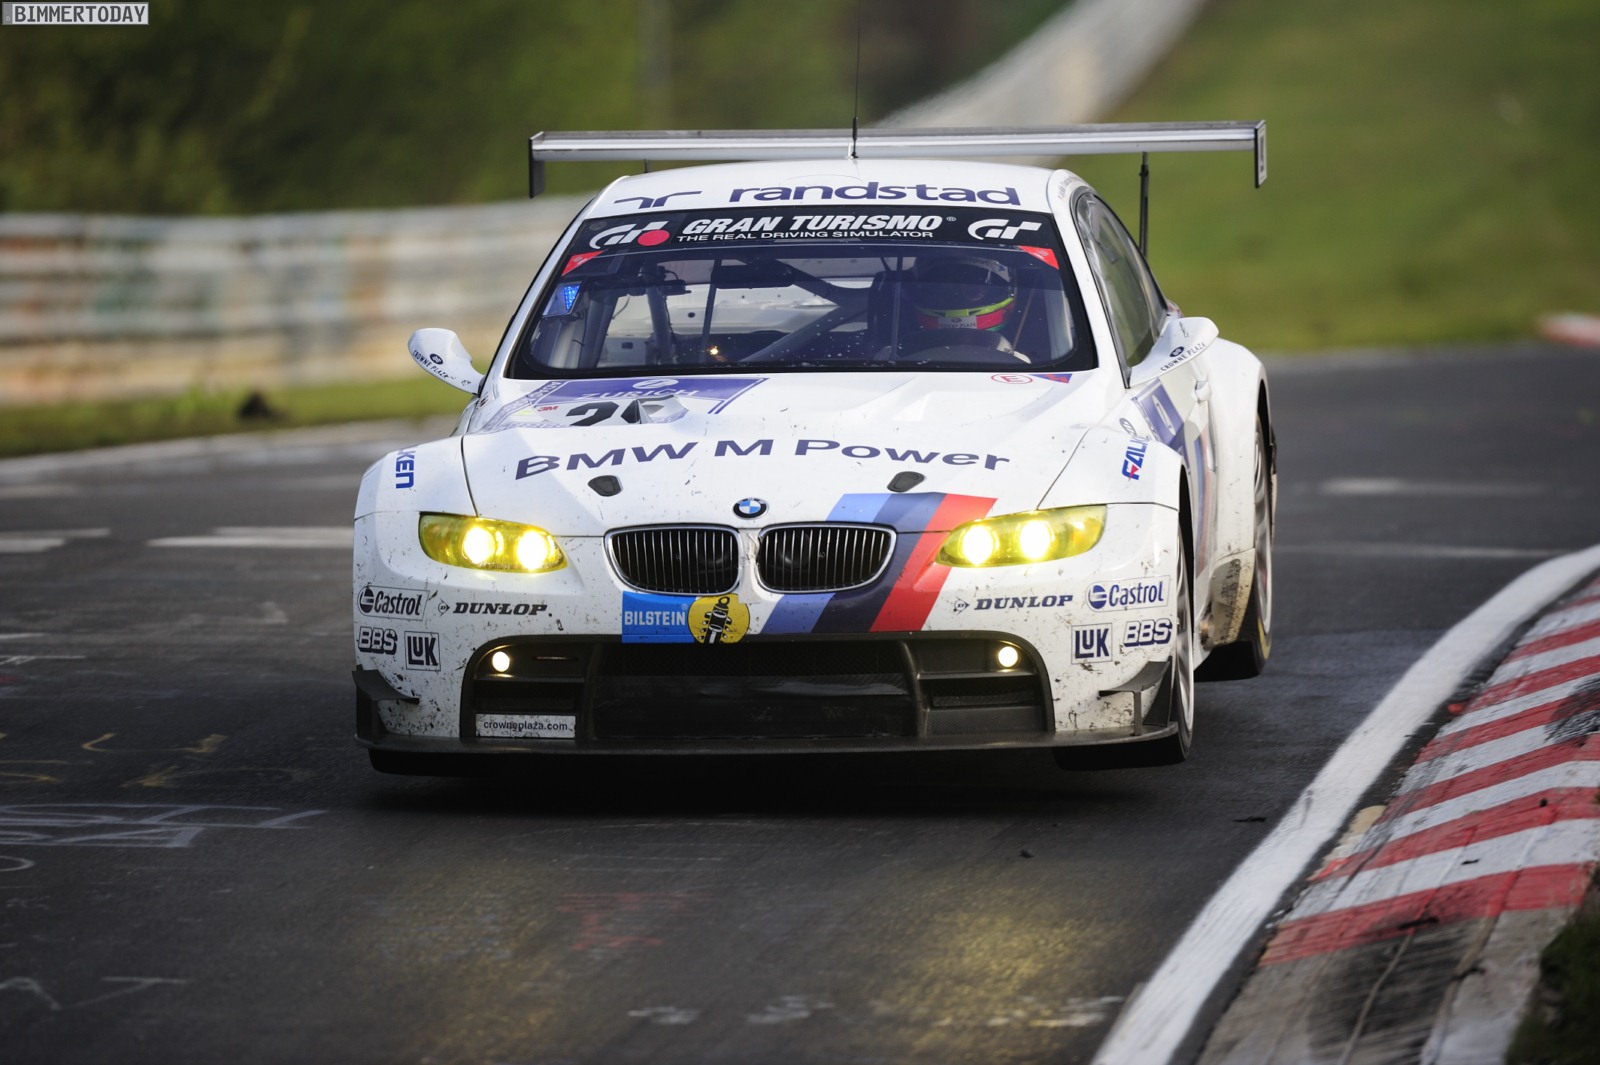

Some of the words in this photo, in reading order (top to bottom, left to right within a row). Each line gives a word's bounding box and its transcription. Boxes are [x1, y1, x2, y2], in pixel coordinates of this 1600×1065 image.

[729, 181, 1021, 206] randstad
[681, 215, 784, 235] GRAN
[792, 214, 943, 232] TURISMO
[676, 234, 709, 242] THE
[712, 232, 757, 241] REAL
[760, 231, 828, 239] DRIVING
[831, 230, 934, 238] SIMULATOR
[1160, 354, 1188, 372] CROWNE
[577, 388, 699, 400] ZURICH
[515, 441, 699, 480] BMW
[714, 439, 774, 457] M
[794, 439, 1010, 471] Power
[373, 590, 423, 616] Castrol
[974, 594, 1074, 611] DUNLOP
[1108, 580, 1164, 607] Castrol
[453, 602, 548, 616] DUNLOP
[624, 611, 686, 626] BILSTEIN
[358, 626, 398, 655] BBS
[1123, 618, 1173, 648] BBS
[483, 720, 568, 732] crowneplaza.com
